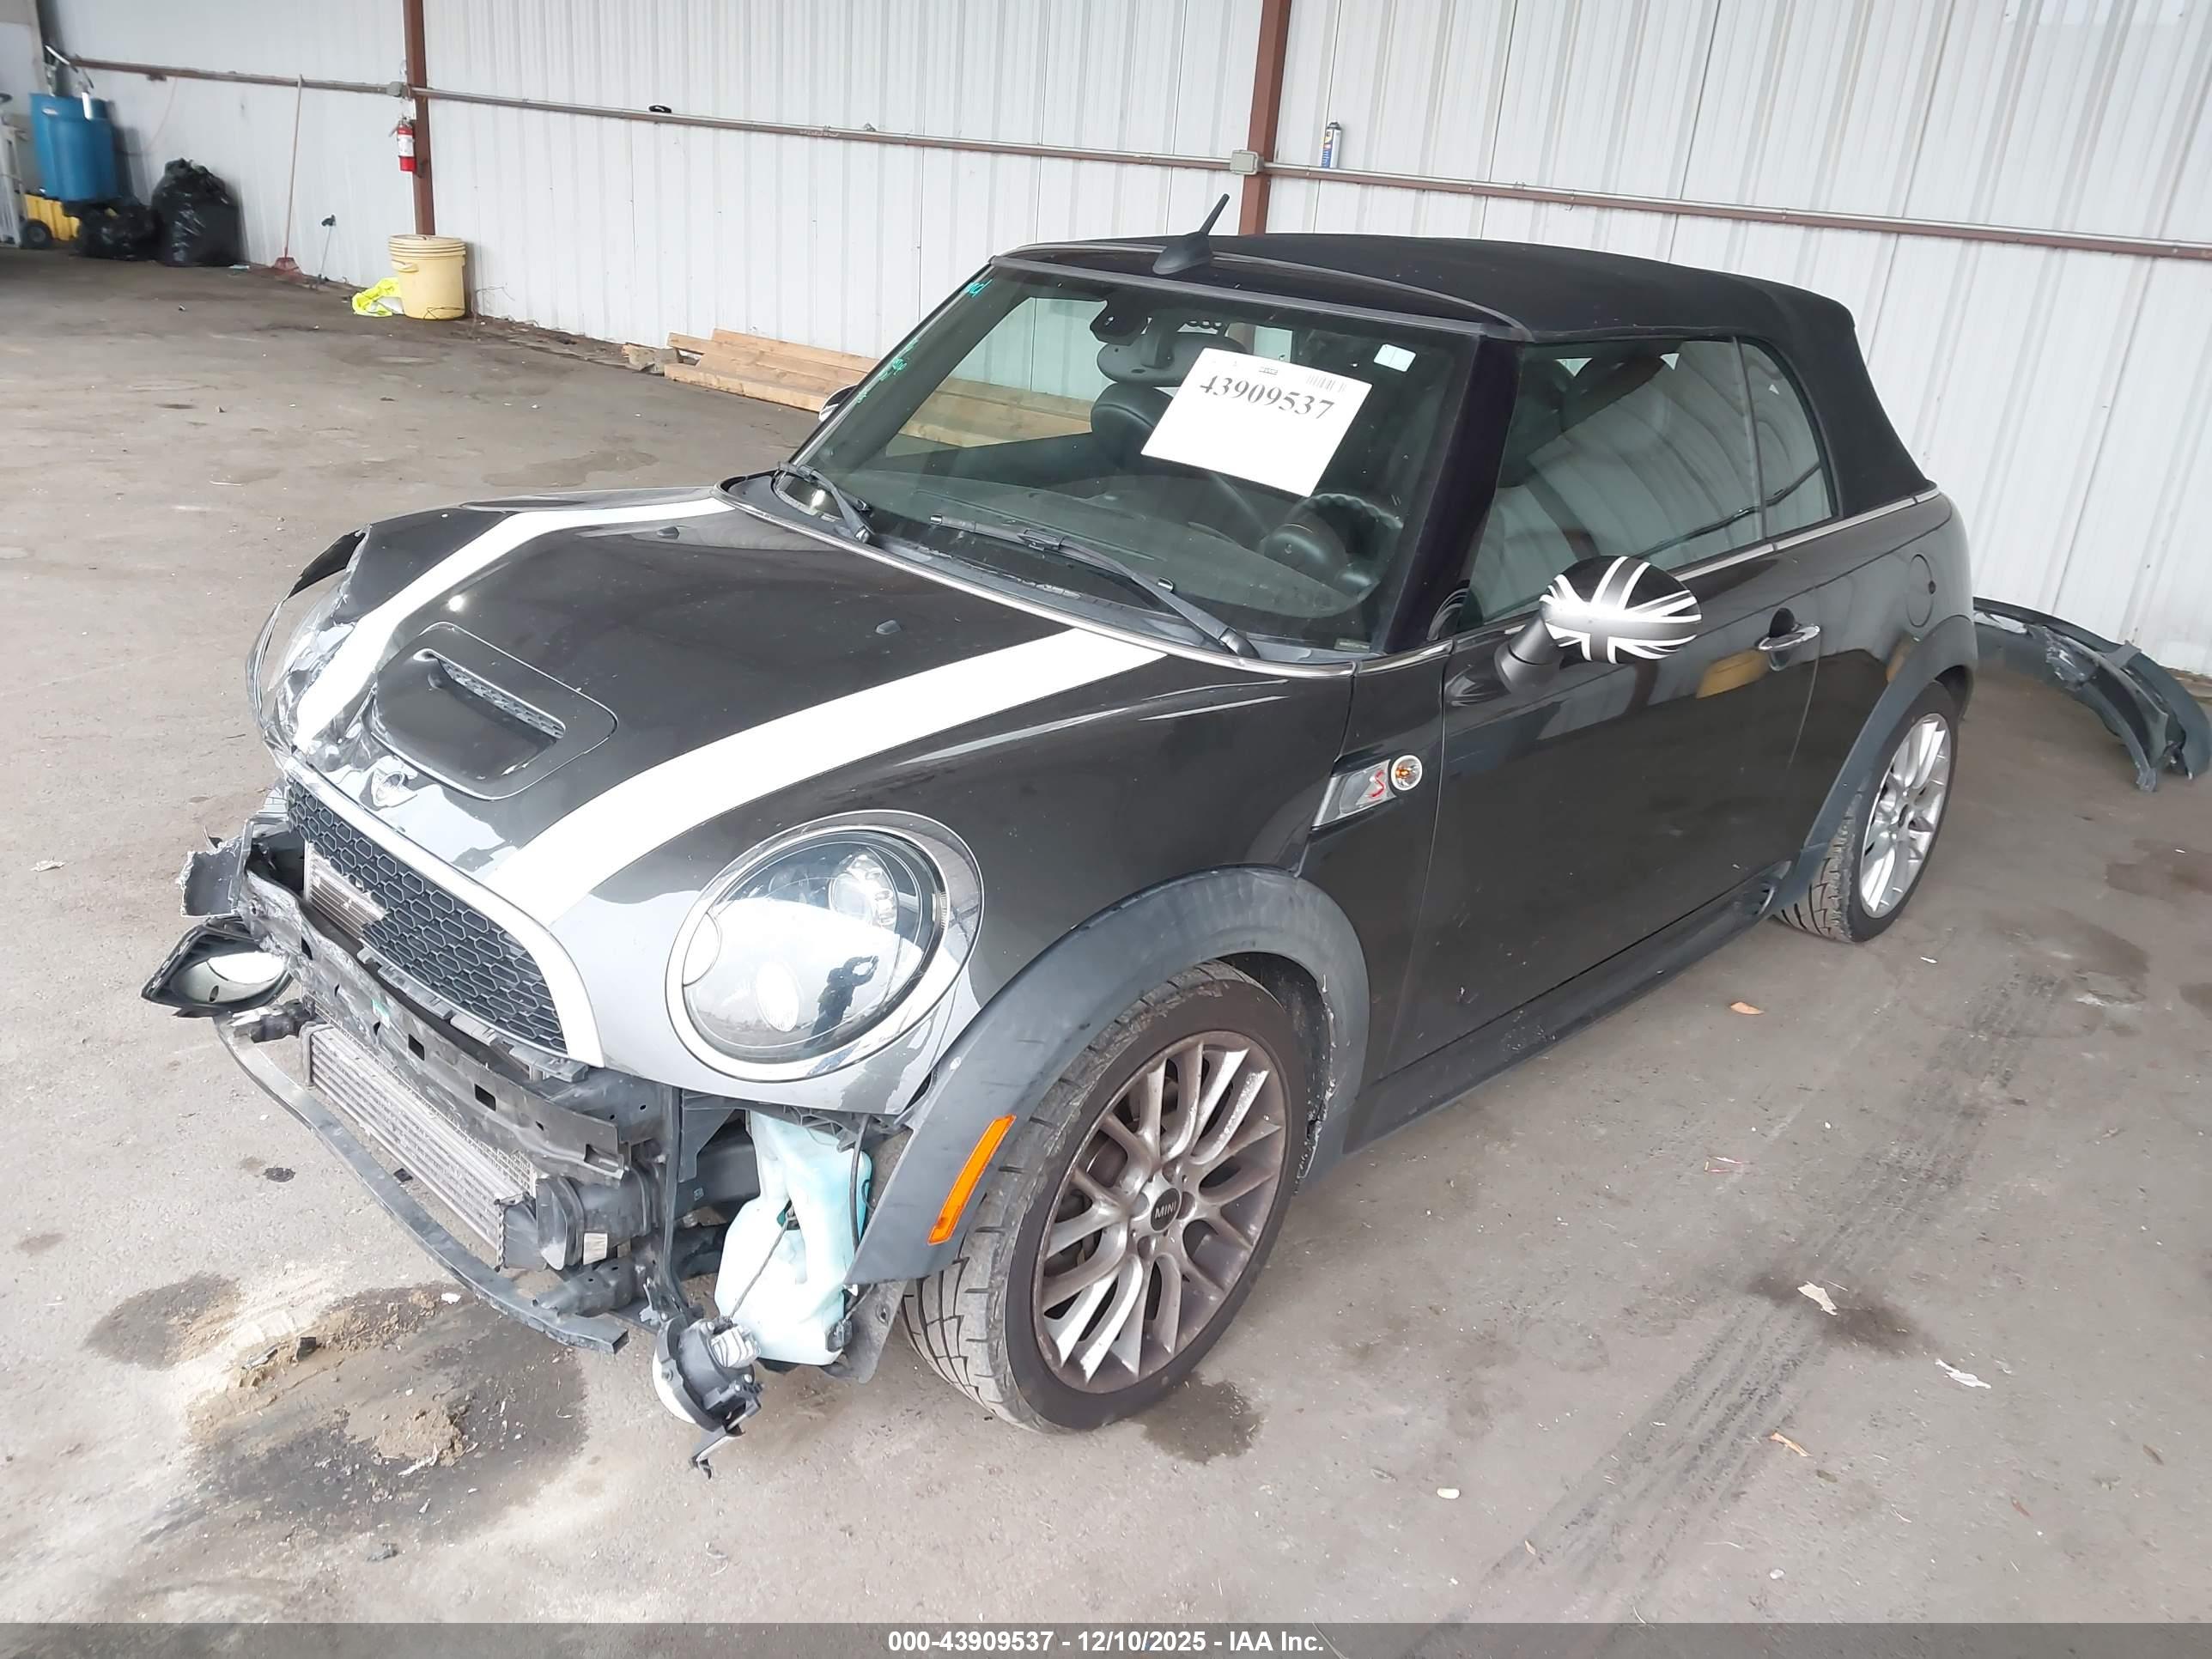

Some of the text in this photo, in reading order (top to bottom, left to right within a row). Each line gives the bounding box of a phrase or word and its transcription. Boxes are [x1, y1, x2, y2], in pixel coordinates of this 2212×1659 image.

[1200, 375, 1335, 419] 43909537
[1369, 770, 1385, 798] S
[1154, 1200, 1176, 1218] MINI
